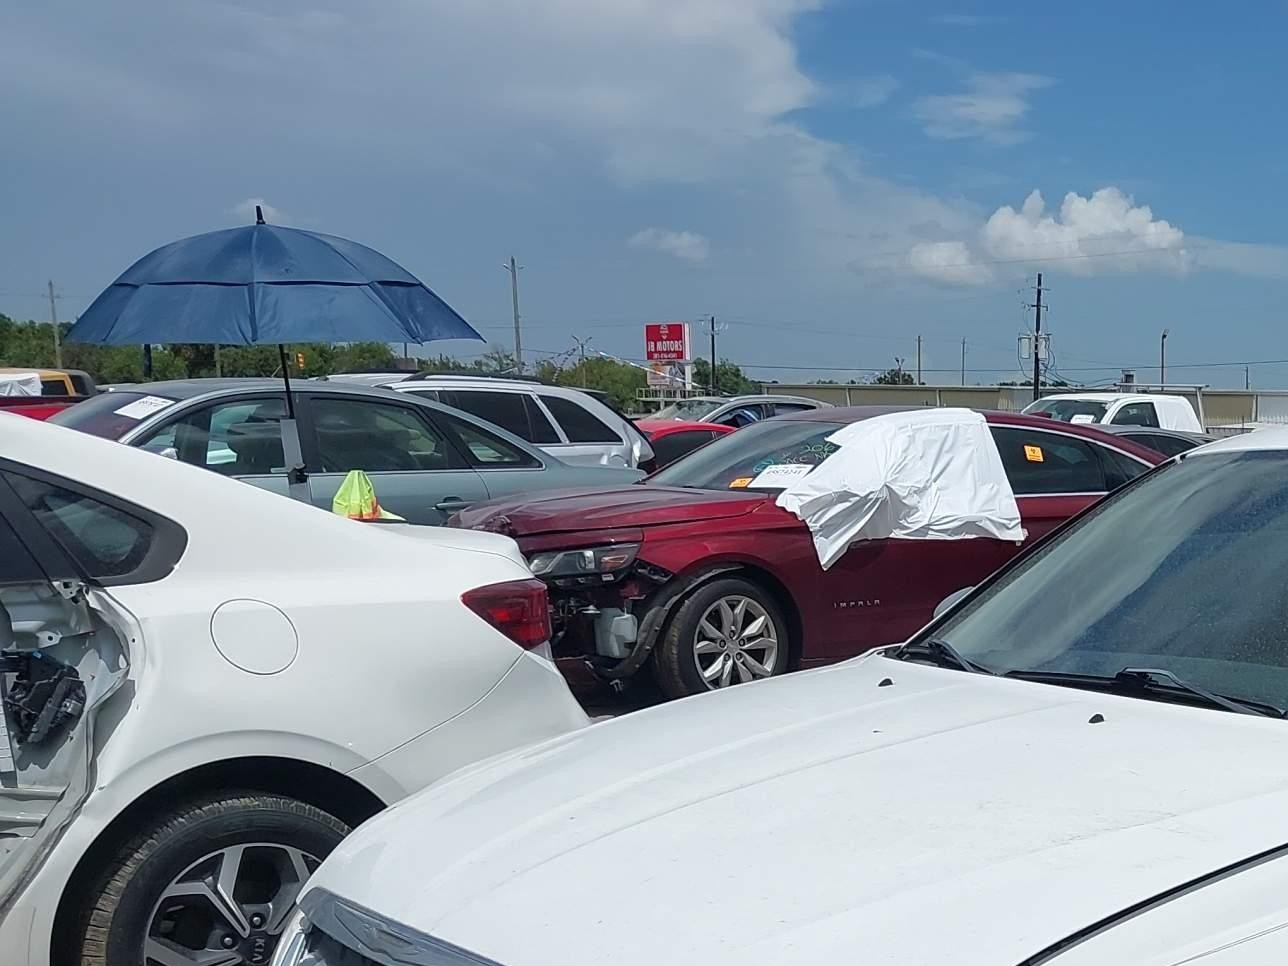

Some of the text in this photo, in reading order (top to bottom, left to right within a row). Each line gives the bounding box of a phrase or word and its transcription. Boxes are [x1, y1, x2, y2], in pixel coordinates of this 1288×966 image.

[656, 340, 683, 352] MOTORS
[833, 599, 880, 609] IMPALA
[251, 938, 265, 961] KIA
